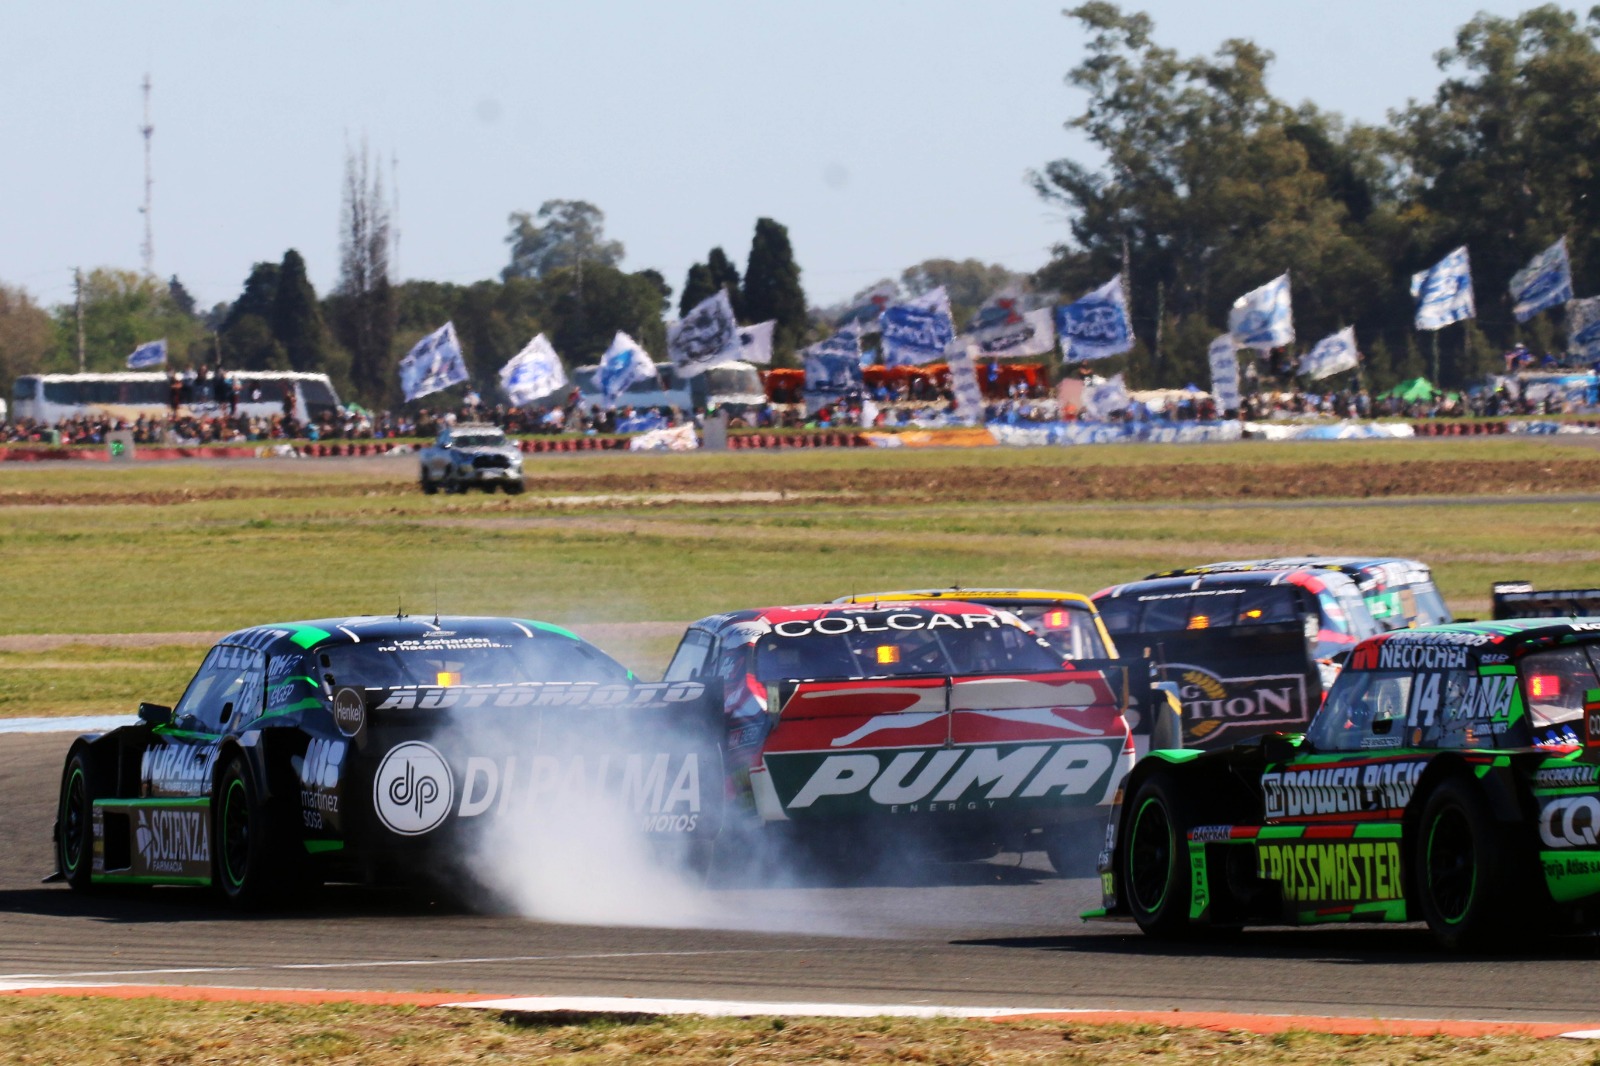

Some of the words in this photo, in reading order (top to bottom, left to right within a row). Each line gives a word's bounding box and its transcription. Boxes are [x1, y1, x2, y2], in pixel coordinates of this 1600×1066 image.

[774, 613, 1001, 638] COLCAR
[394, 639, 420, 647] Los
[423, 637, 490, 646] cobardes
[400, 643, 444, 651] hacen
[1380, 645, 1468, 669] NECOCHEA
[375, 680, 706, 710] AUTOMOTO
[1408, 672, 1442, 727] 14
[336, 701, 362, 722] Henkel
[787, 744, 1112, 809] PUMA
[890, 800, 997, 815] ENERGY
[302, 811, 323, 831] sosa
[641, 813, 699, 833] MOTOS
[152, 810, 209, 862] SCIENZA
